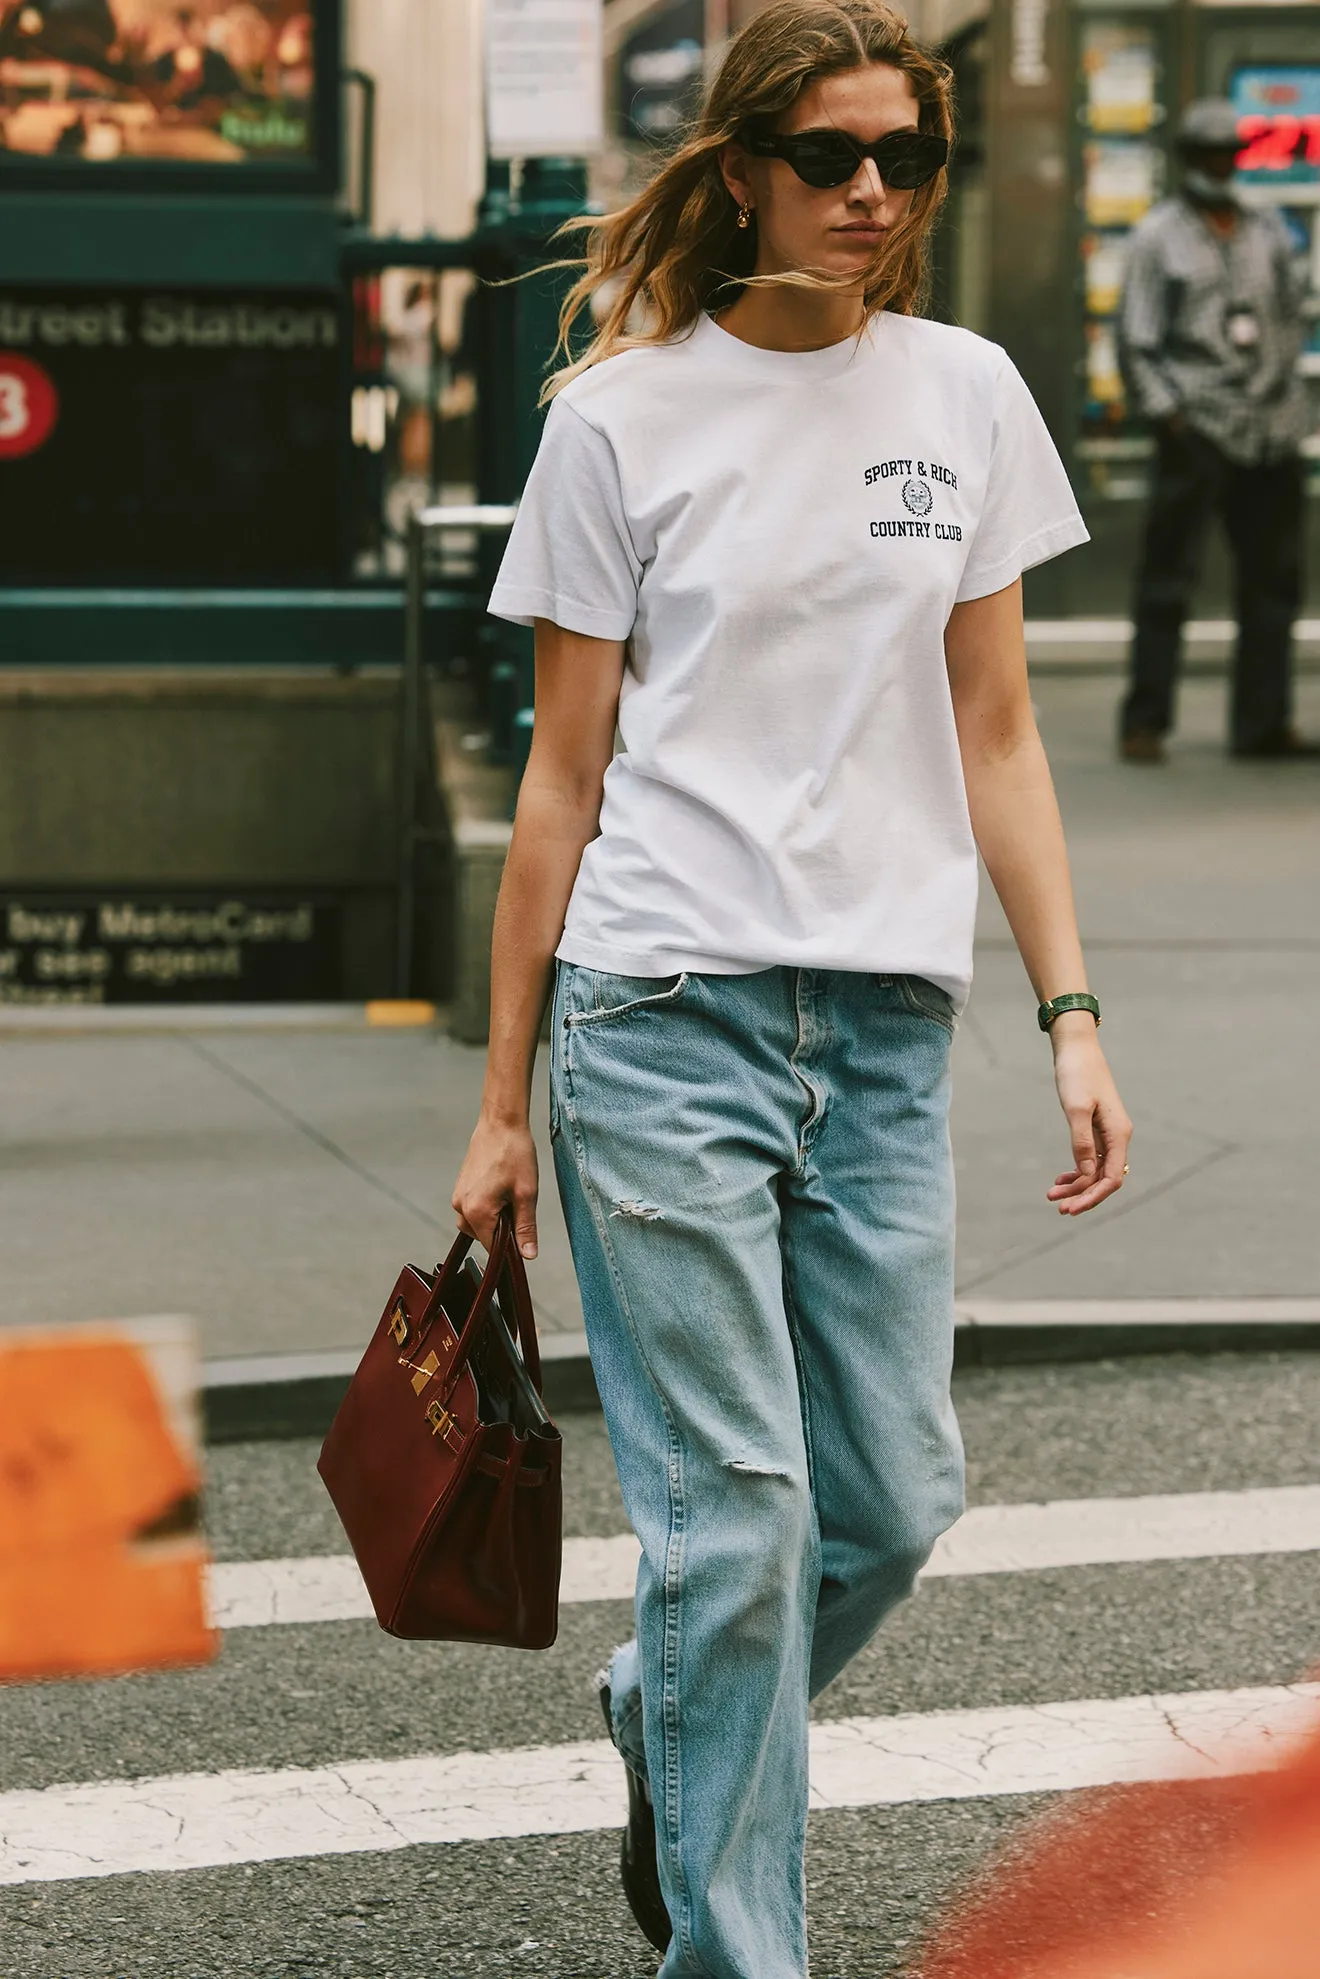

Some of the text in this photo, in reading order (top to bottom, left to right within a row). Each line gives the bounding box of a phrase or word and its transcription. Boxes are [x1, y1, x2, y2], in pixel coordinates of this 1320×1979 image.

[141, 300, 337, 346] Station
[864, 459, 958, 490] SPORTY & RICH
[869, 521, 962, 541] COUNTRY CLUB
[100, 902, 311, 941] MetroCard
